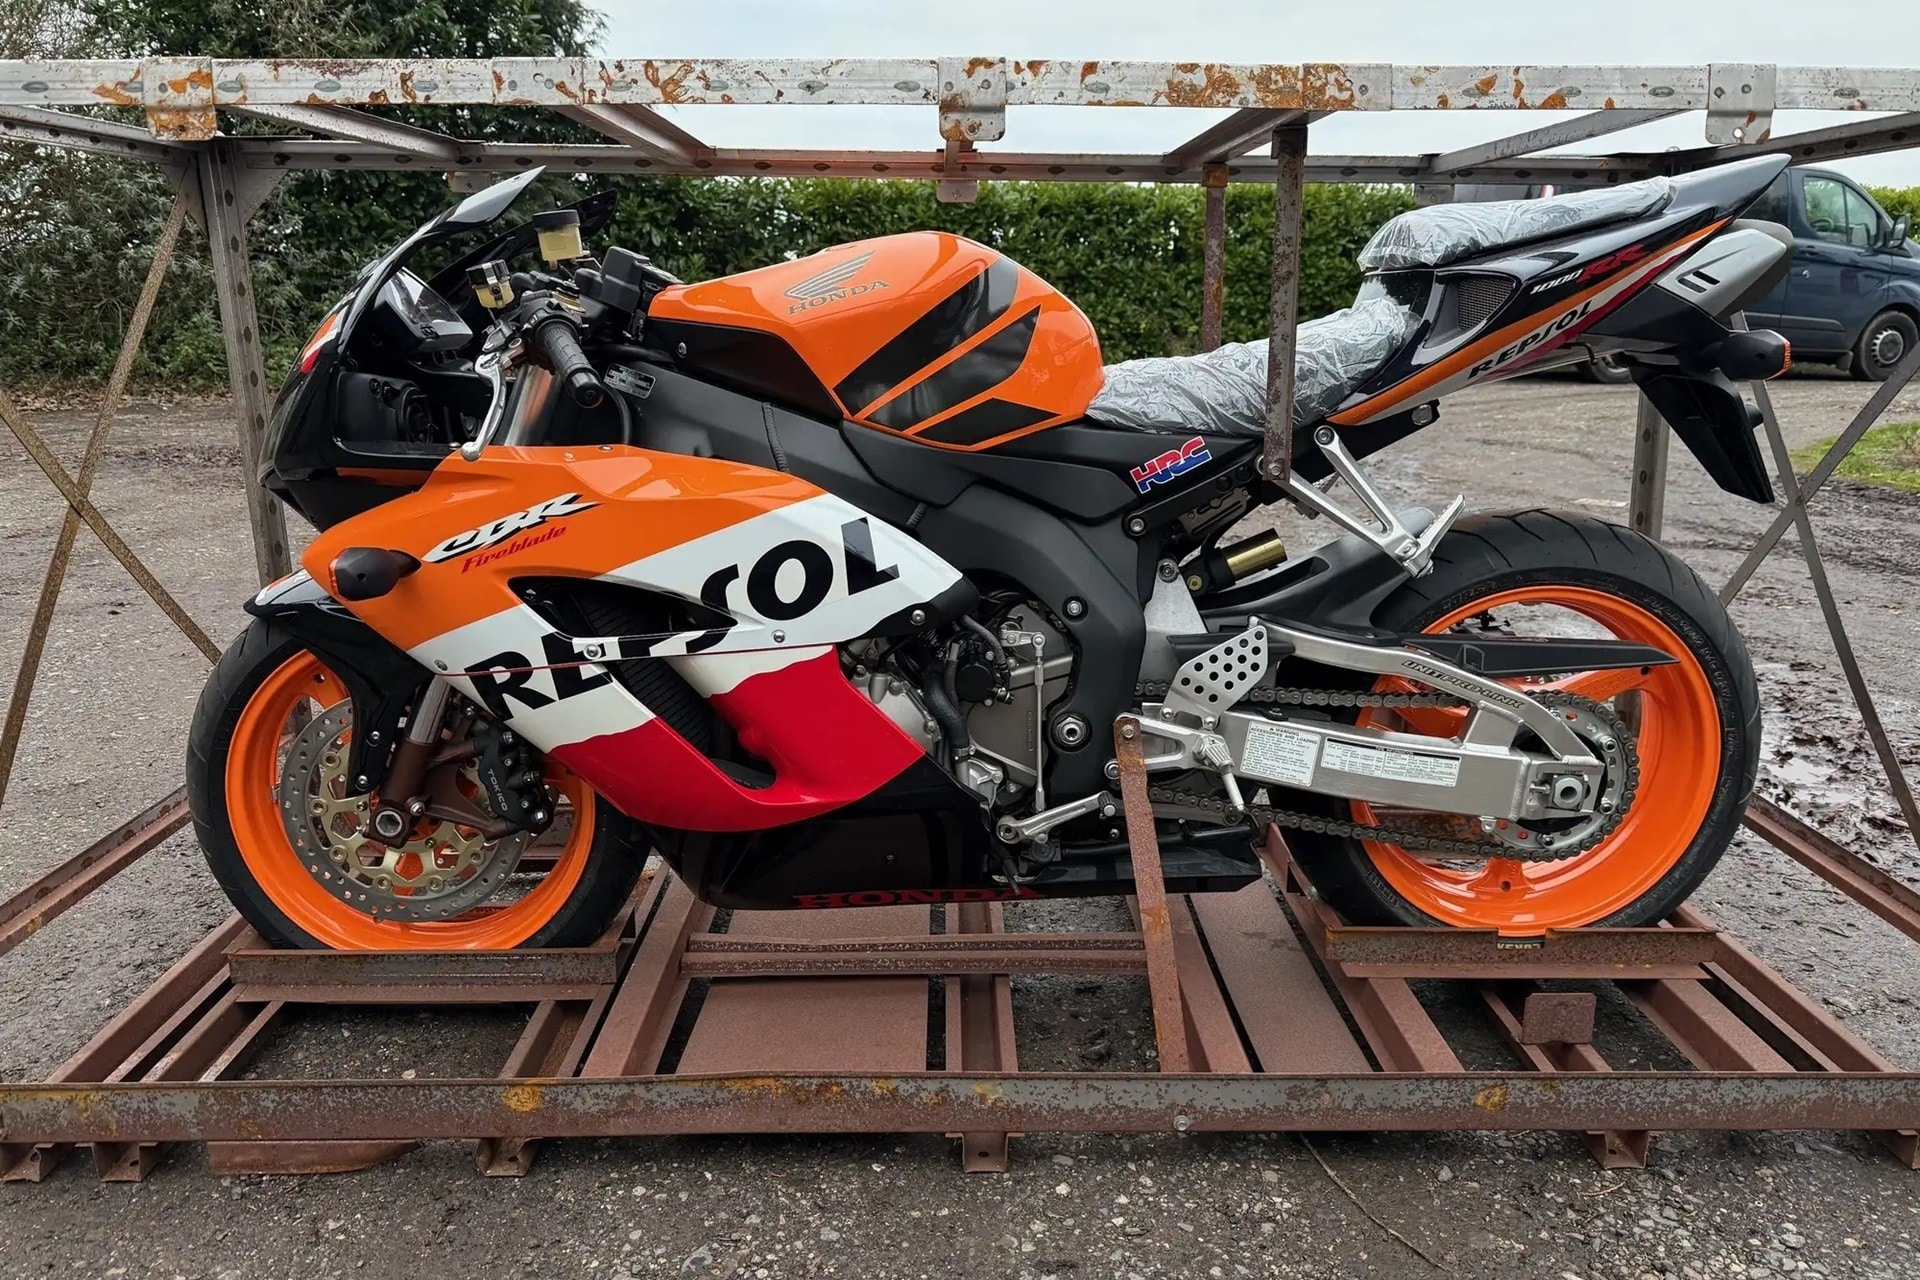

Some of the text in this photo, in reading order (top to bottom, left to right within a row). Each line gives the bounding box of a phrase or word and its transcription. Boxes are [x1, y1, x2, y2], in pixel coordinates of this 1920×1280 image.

[787, 280, 891, 316] HONDA
[1467, 300, 1593, 380] REPSOL
[1129, 435, 1213, 494] HRC
[421, 492, 603, 564] CBR
[462, 525, 567, 575] Fireblade
[464, 516, 900, 722] RESOL
[1402, 659, 1442, 682] UNIT
[487, 768, 508, 811] TOKICO
[793, 886, 1044, 909] HONDA
